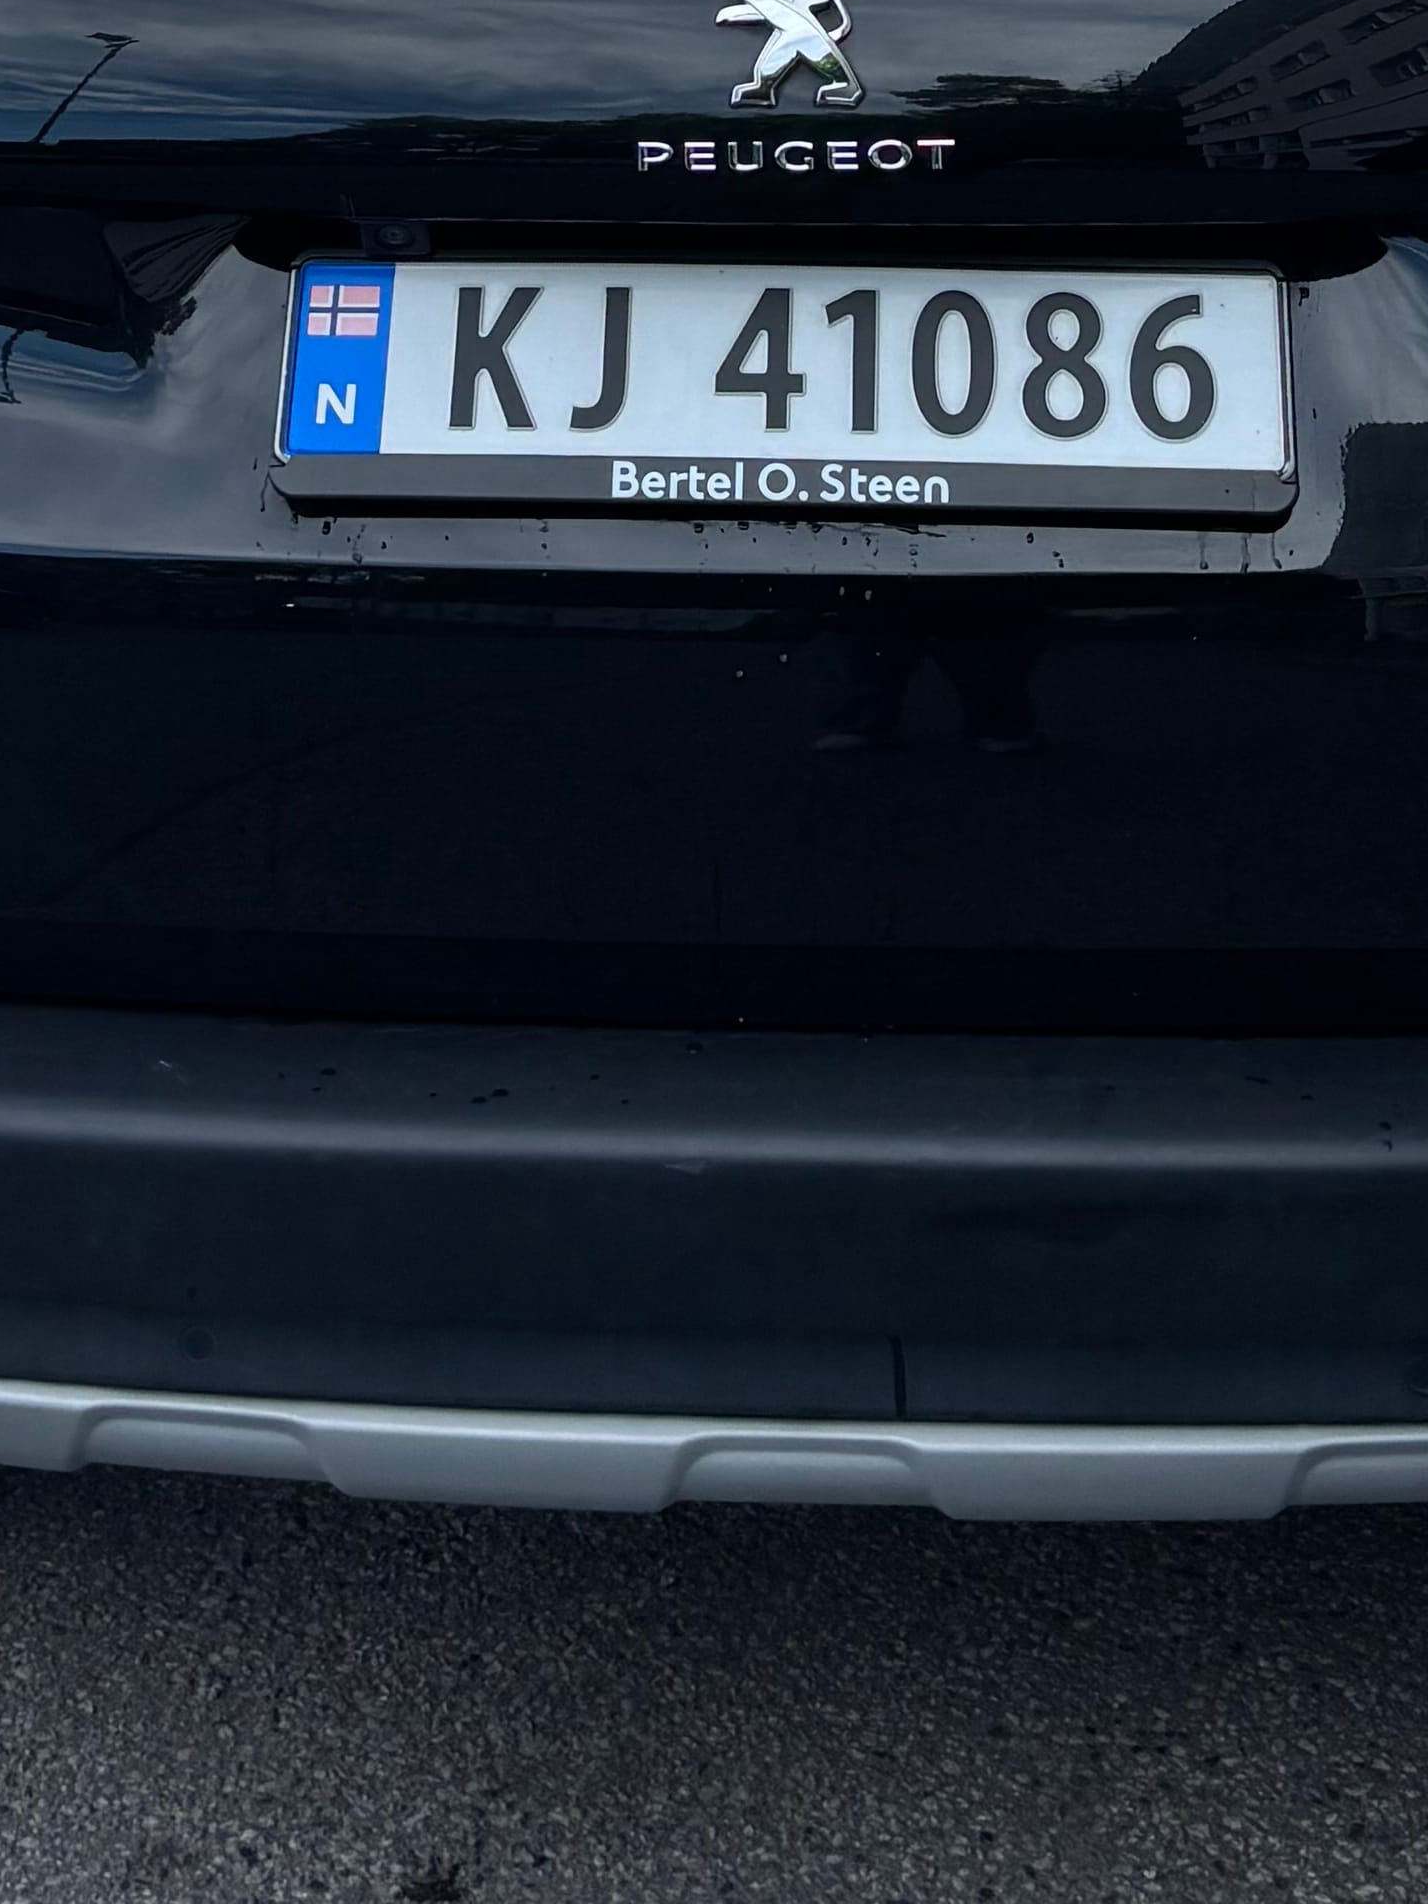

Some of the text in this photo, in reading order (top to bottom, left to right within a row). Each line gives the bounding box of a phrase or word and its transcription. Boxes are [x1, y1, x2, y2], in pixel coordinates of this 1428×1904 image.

[637, 138, 956, 173] PEUGEOT
[448, 285, 1219, 443] KJ 41086
[315, 382, 357, 425] N
[611, 459, 950, 505] Bertel O. Steen
